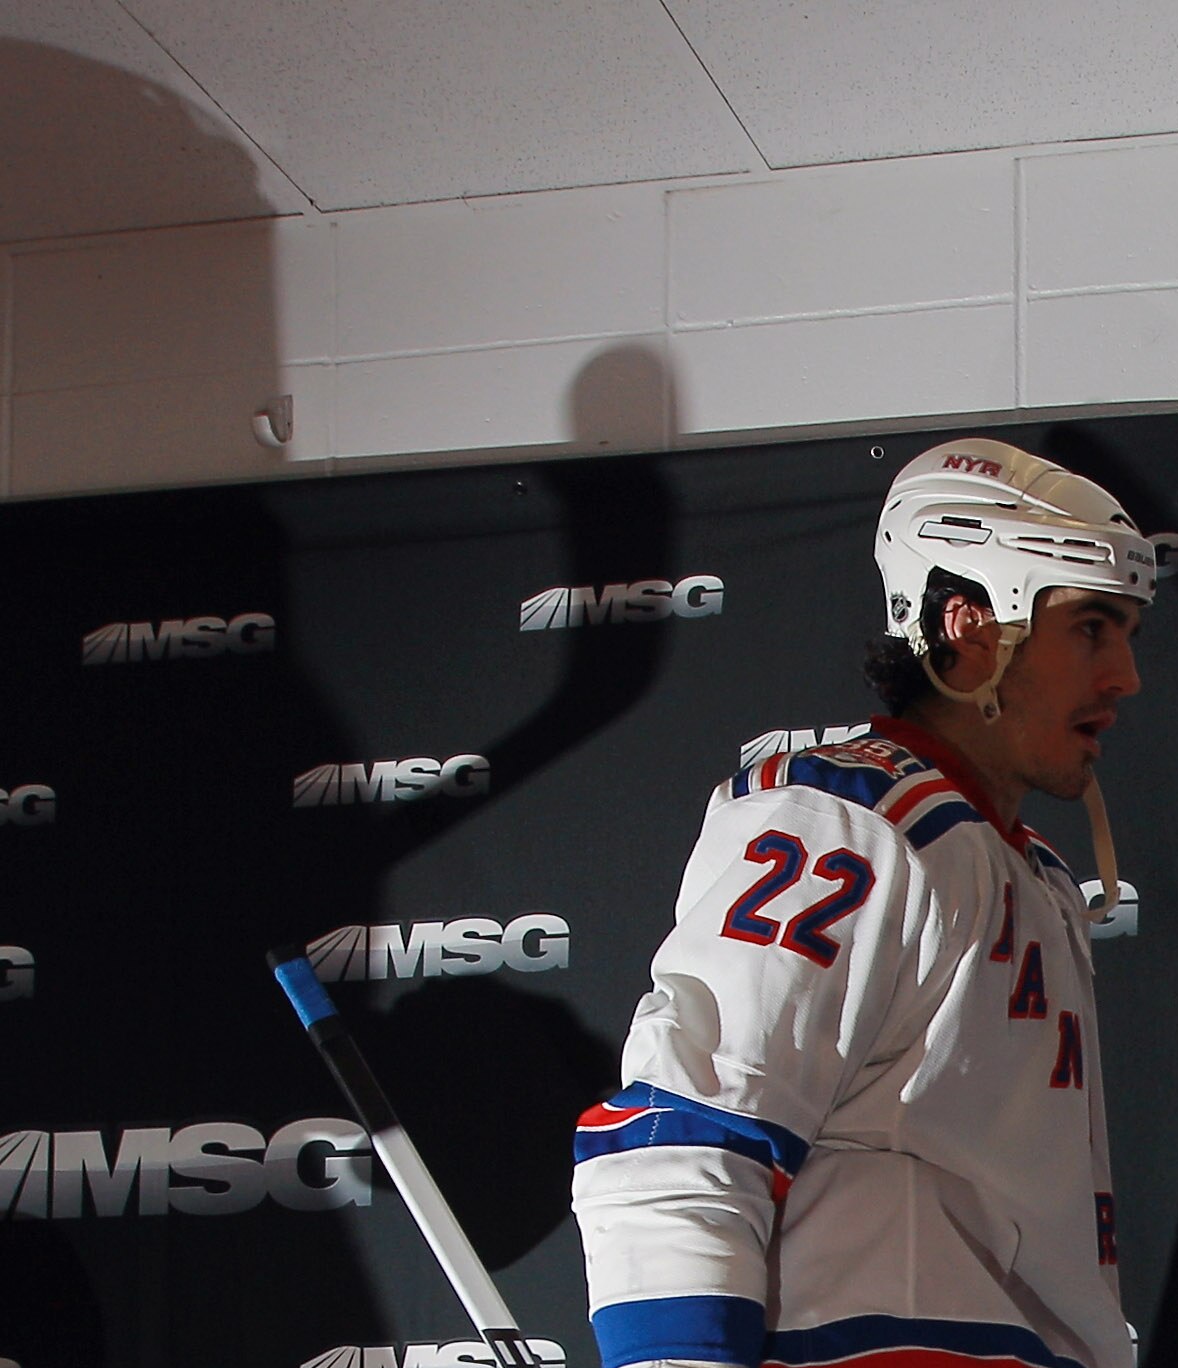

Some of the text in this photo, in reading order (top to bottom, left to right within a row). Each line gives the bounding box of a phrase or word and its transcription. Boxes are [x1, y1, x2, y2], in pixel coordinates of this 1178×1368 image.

[942, 453, 1003, 477] NYR
[574, 574, 725, 625] MSG
[130, 613, 275, 661] MSG
[342, 754, 491, 801] MSG
[721, 829, 876, 969] 22
[371, 913, 570, 979] MSG
[53, 1117, 373, 1217] MSG
